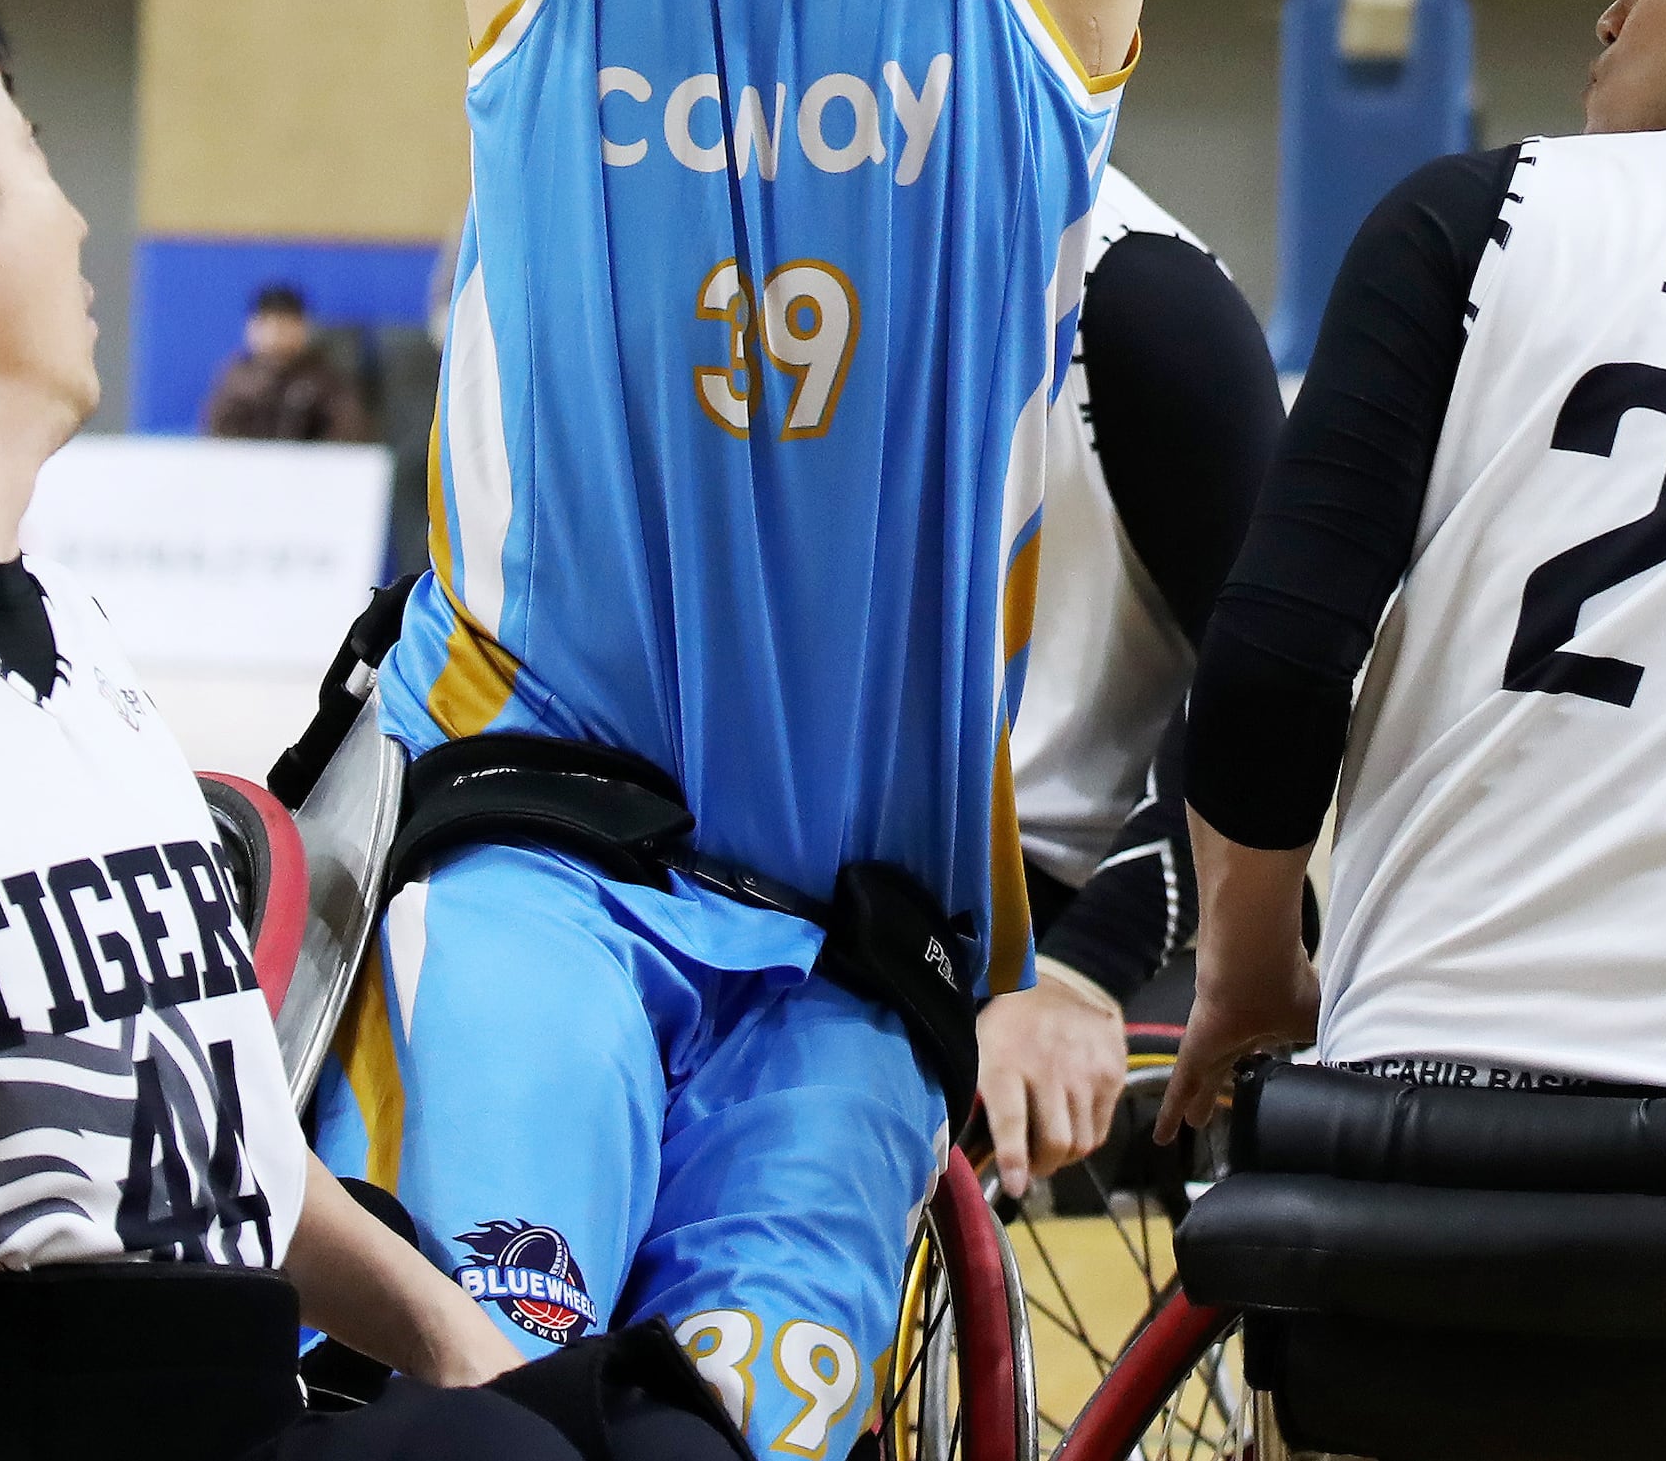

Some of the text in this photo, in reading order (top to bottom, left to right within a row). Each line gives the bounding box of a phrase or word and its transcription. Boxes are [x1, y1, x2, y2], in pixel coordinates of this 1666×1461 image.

[598, 52, 953, 186] coway
[692, 256, 862, 442] 39
[115, 1040, 273, 1270] 44
[510, 1310, 568, 1344] coway
[674, 1308, 861, 1461] 39
